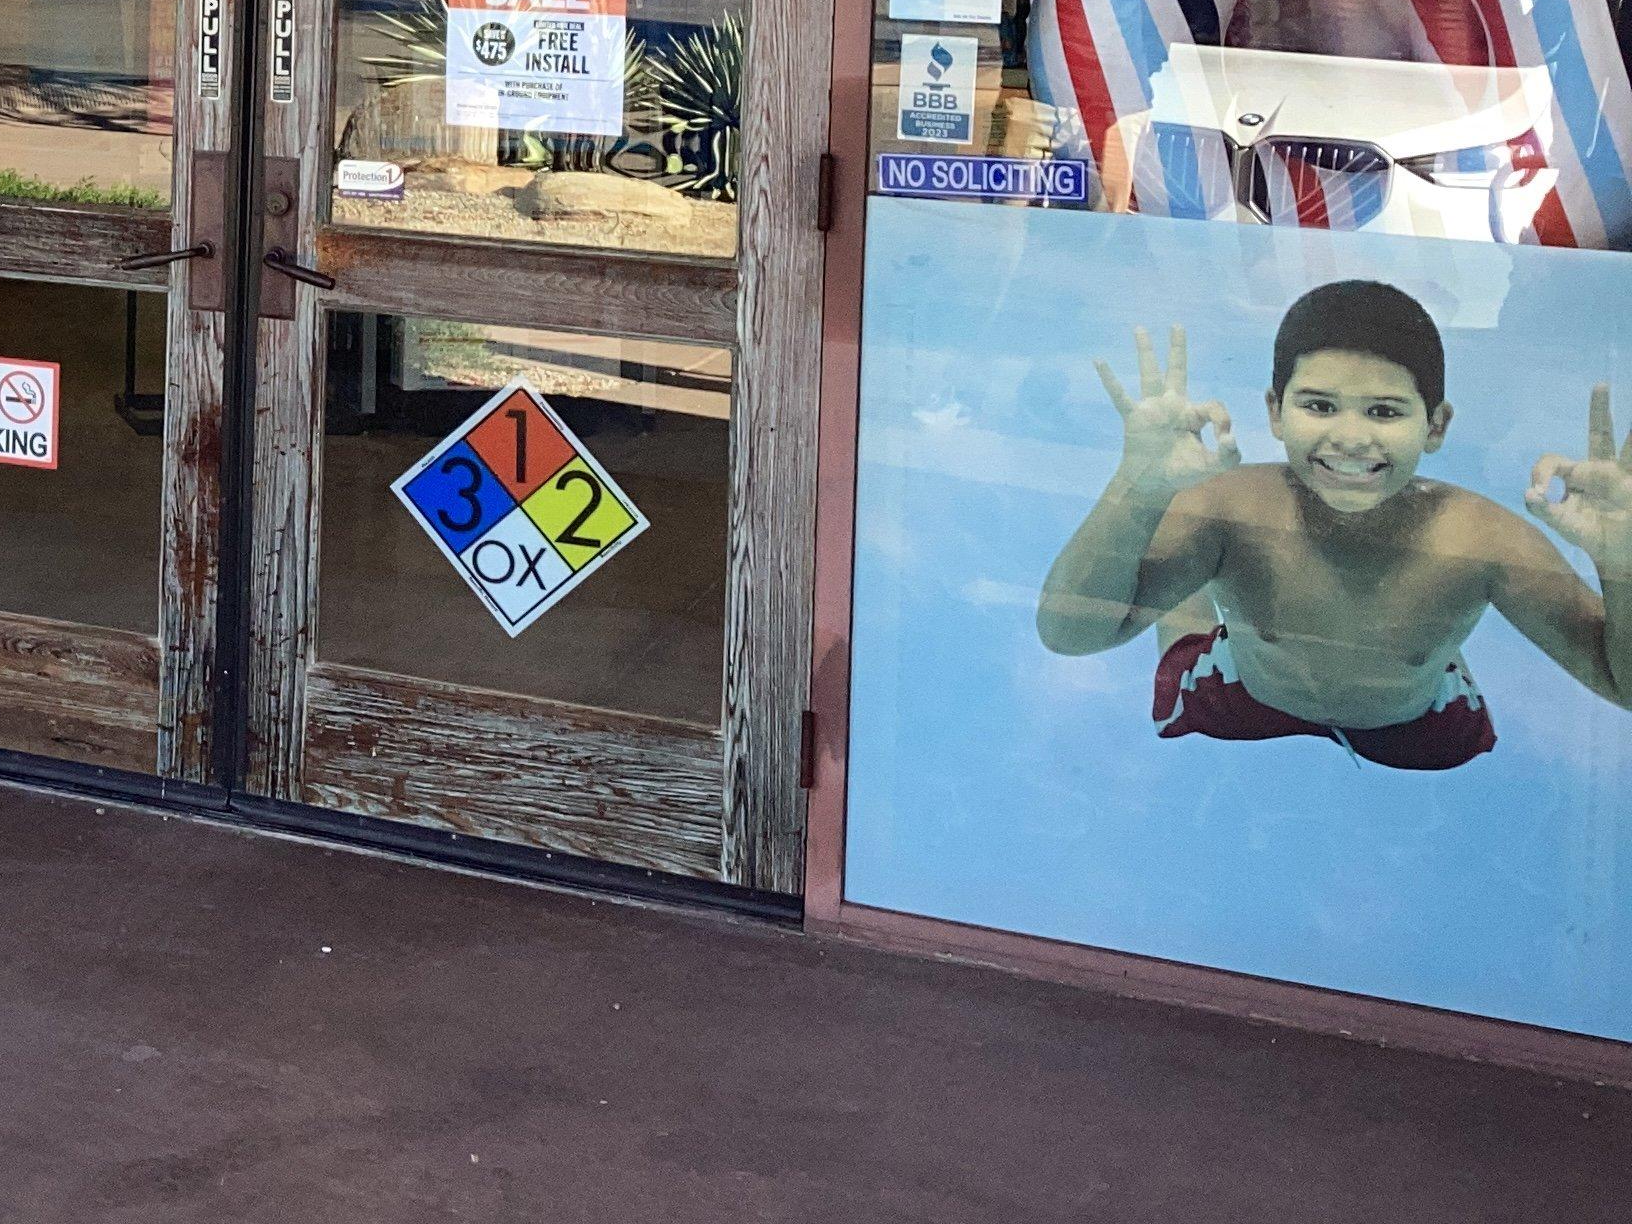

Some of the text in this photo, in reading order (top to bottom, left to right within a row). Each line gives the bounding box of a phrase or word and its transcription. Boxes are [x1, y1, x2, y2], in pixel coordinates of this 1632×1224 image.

[275, 0, 291, 76] PULL
[538, 32, 579, 51] FREE
[475, 39, 507, 59] $475
[525, 54, 590, 75] INSTALL
[913, 92, 957, 109] BBB
[909, 113, 961, 122] ACCREDITED
[915, 121, 955, 130] BUSINESS
[922, 129, 948, 137] 2023
[888, 159, 1074, 194] NO SOLICITING
[505, 409, 527, 483] 1
[437, 456, 482, 532] 3
[554, 470, 602, 548] 2
[472, 540, 546, 590] OX
